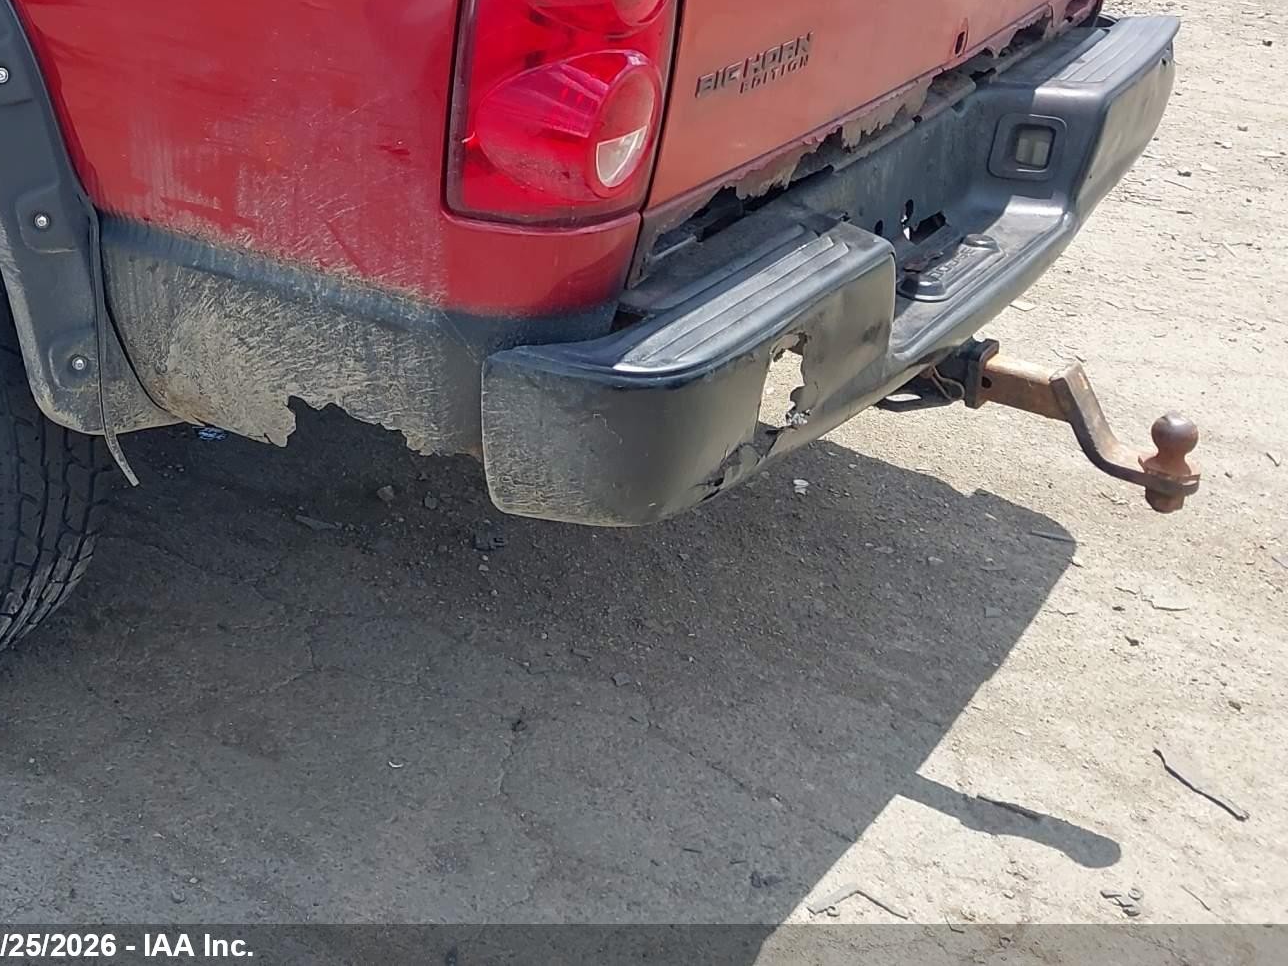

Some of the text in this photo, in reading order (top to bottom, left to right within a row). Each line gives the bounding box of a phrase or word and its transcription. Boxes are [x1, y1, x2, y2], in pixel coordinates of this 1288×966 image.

[694, 32, 813, 99] BIG HORN
[738, 53, 809, 94] EDITION
